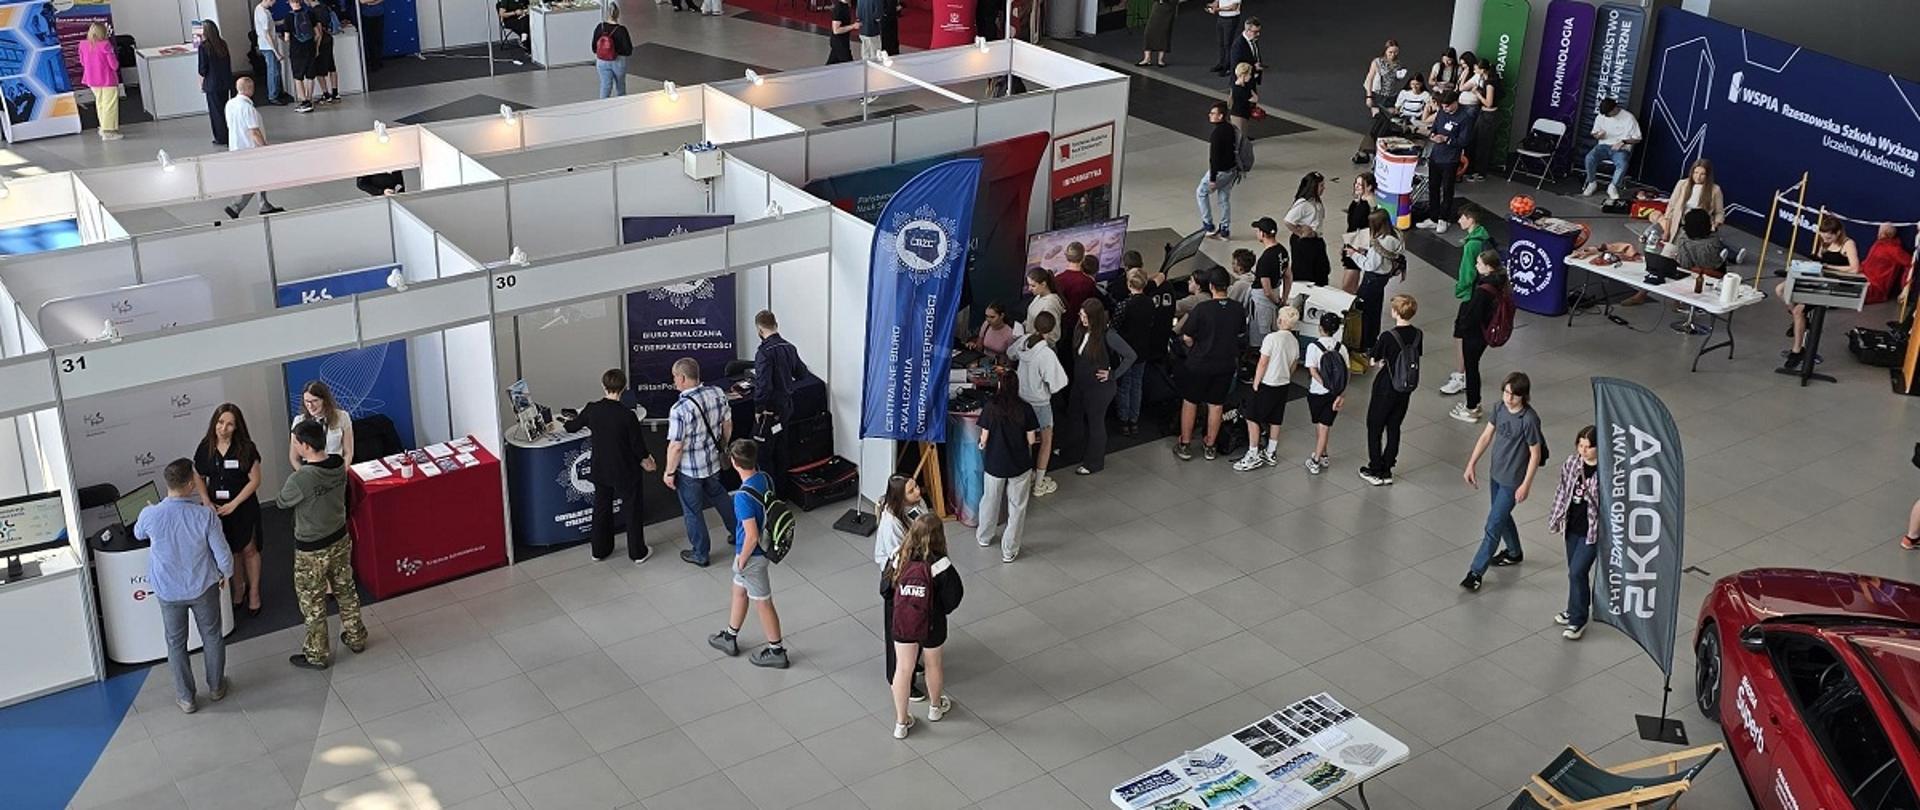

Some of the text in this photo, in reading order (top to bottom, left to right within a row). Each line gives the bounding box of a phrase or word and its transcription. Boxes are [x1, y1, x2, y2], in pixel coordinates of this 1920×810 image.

[1550, 17, 1576, 108] KRYMINOLOGIA
[1742, 87, 1919, 162] WSPIA Rzeszowska Szkoła Wyższa
[1822, 134, 1915, 178] Uczelnia Akademicka
[496, 275, 516, 289] 30
[657, 317, 707, 327] CENTRALNE
[670, 330, 722, 339] ZWALCZANIA
[62, 356, 87, 373] 31
[885, 325, 900, 432] CENTRALNE BIURO
[916, 294, 937, 434] CYBERPRZESTĘPCZOŚCI
[900, 357, 913, 434] ZWALCZANIA
[899, 584, 926, 598] VANS
[1736, 686, 1764, 755] Superb
